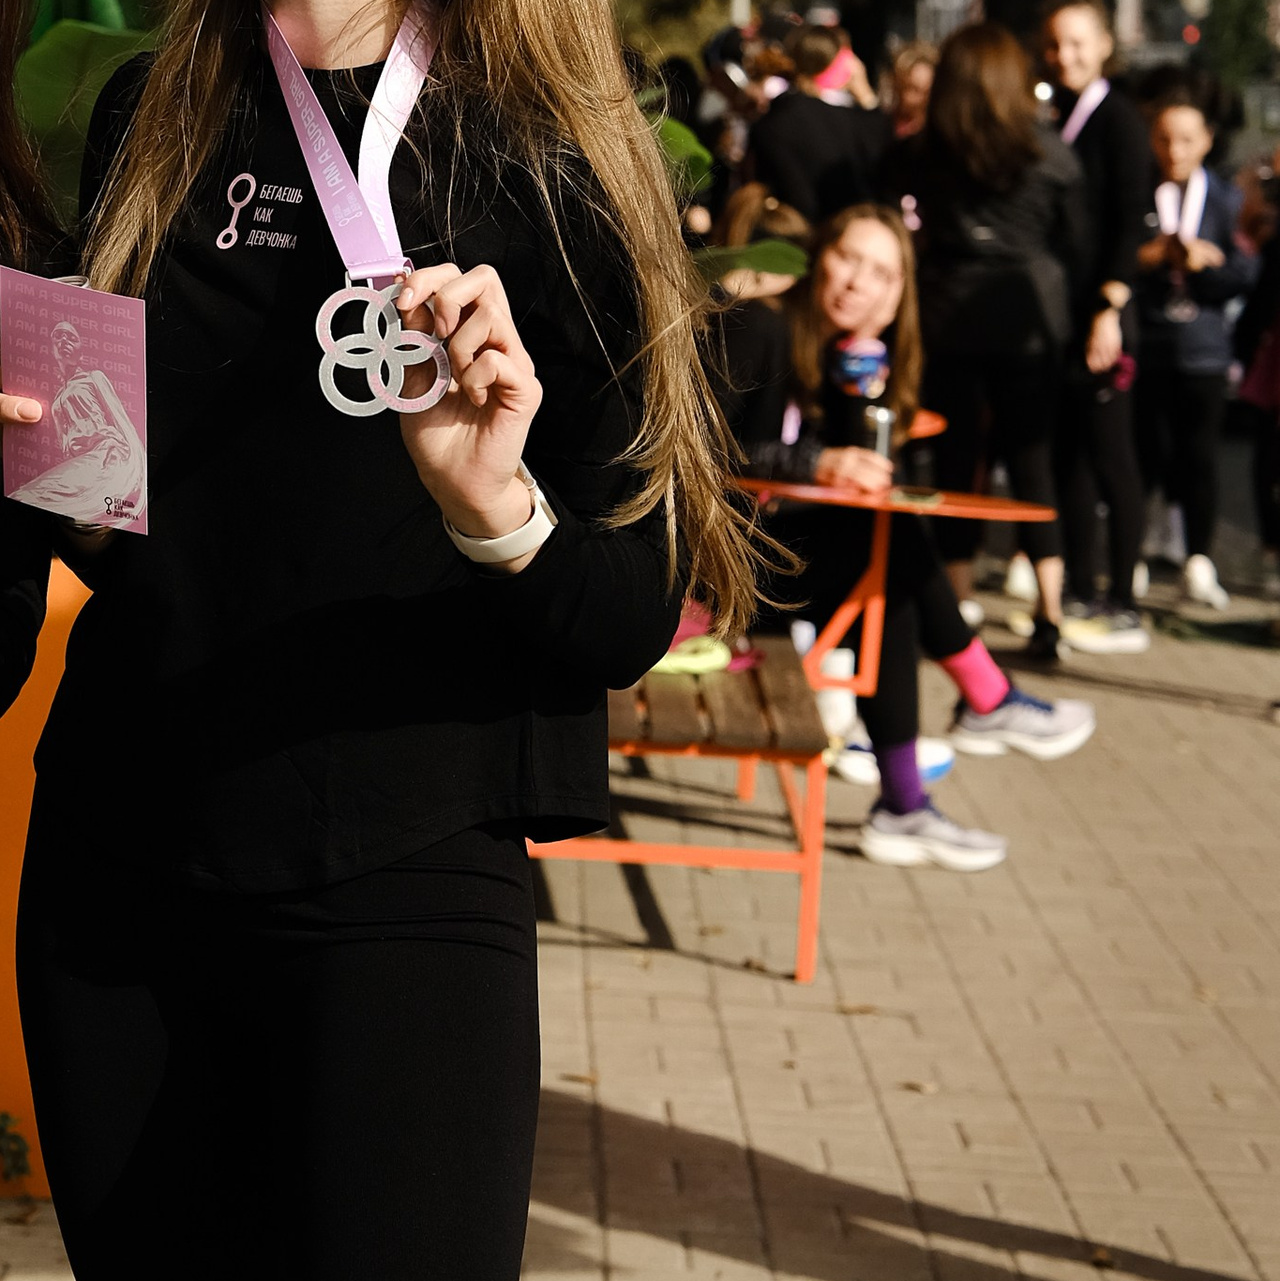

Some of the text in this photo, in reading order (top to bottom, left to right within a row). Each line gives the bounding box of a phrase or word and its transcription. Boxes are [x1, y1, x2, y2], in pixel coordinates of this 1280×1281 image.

[289, 70, 346, 197] I AM A SUPER GIRL
[259, 184, 303, 204] БЕГАЕШЬ
[253, 206, 274, 223] КАК
[245, 229, 297, 250] ДЕВЧОНКА
[15, 282, 34, 296] AM
[39, 288, 47, 300] A
[53, 292, 98, 312] SUPER
[103, 303, 135, 321] GIRL
[15, 301, 34, 314] AM
[39, 308, 48, 318] A
[104, 323, 136, 339] GIRL
[16, 319, 35, 332] AM
[39, 326, 48, 336] A
[104, 341, 136, 357] GIRL
[16, 338, 35, 351] AM
[40, 344, 48, 355] A
[104, 360, 136, 376] GIRL
[16, 356, 36, 369] AM
[40, 362, 48, 373] A
[17, 374, 36, 387] AM
[40, 381, 49, 391] A
